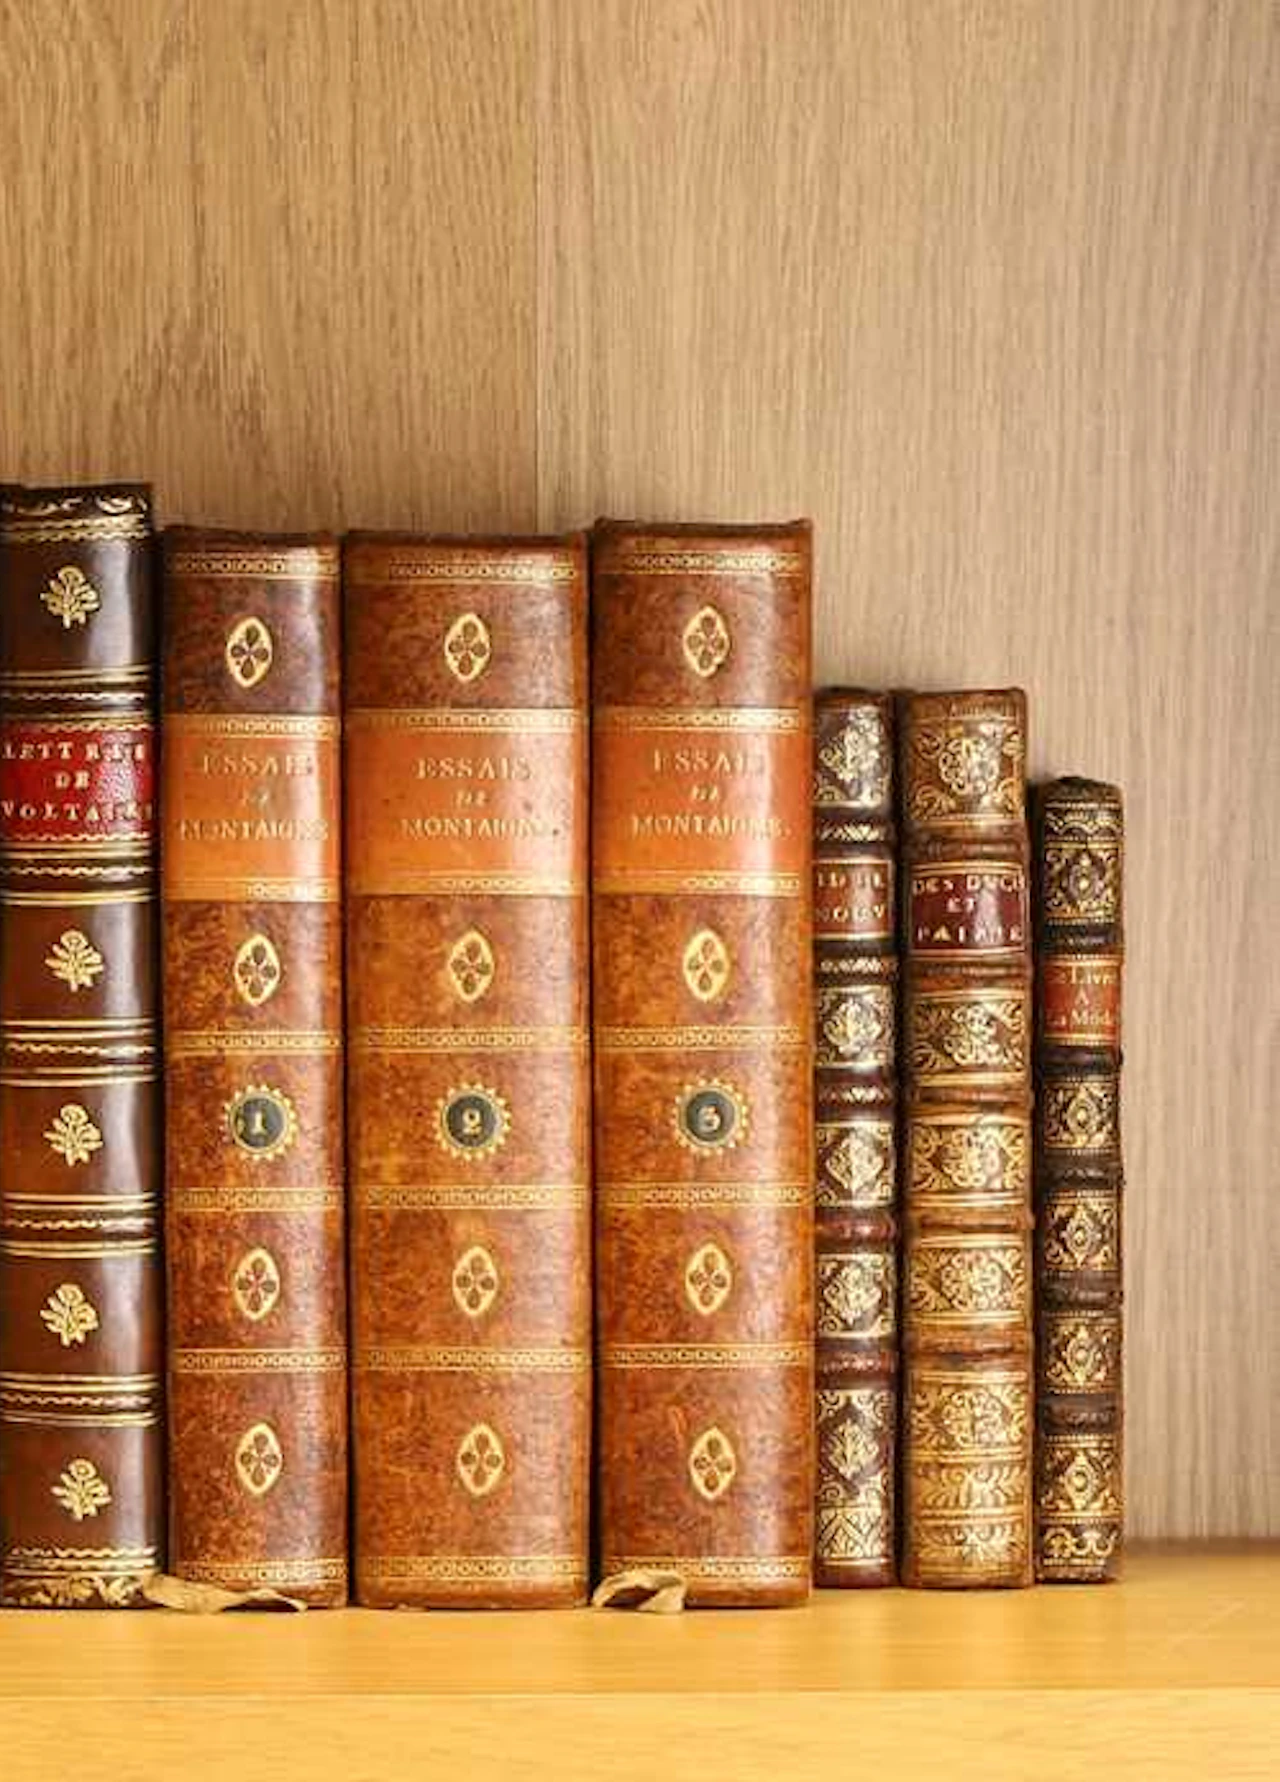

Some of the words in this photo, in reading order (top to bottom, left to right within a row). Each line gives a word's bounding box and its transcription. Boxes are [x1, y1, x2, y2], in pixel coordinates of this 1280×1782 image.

[55, 770, 91, 790] DE
[252, 1111, 265, 1135] 1
[461, 1107, 481, 1135] 2
